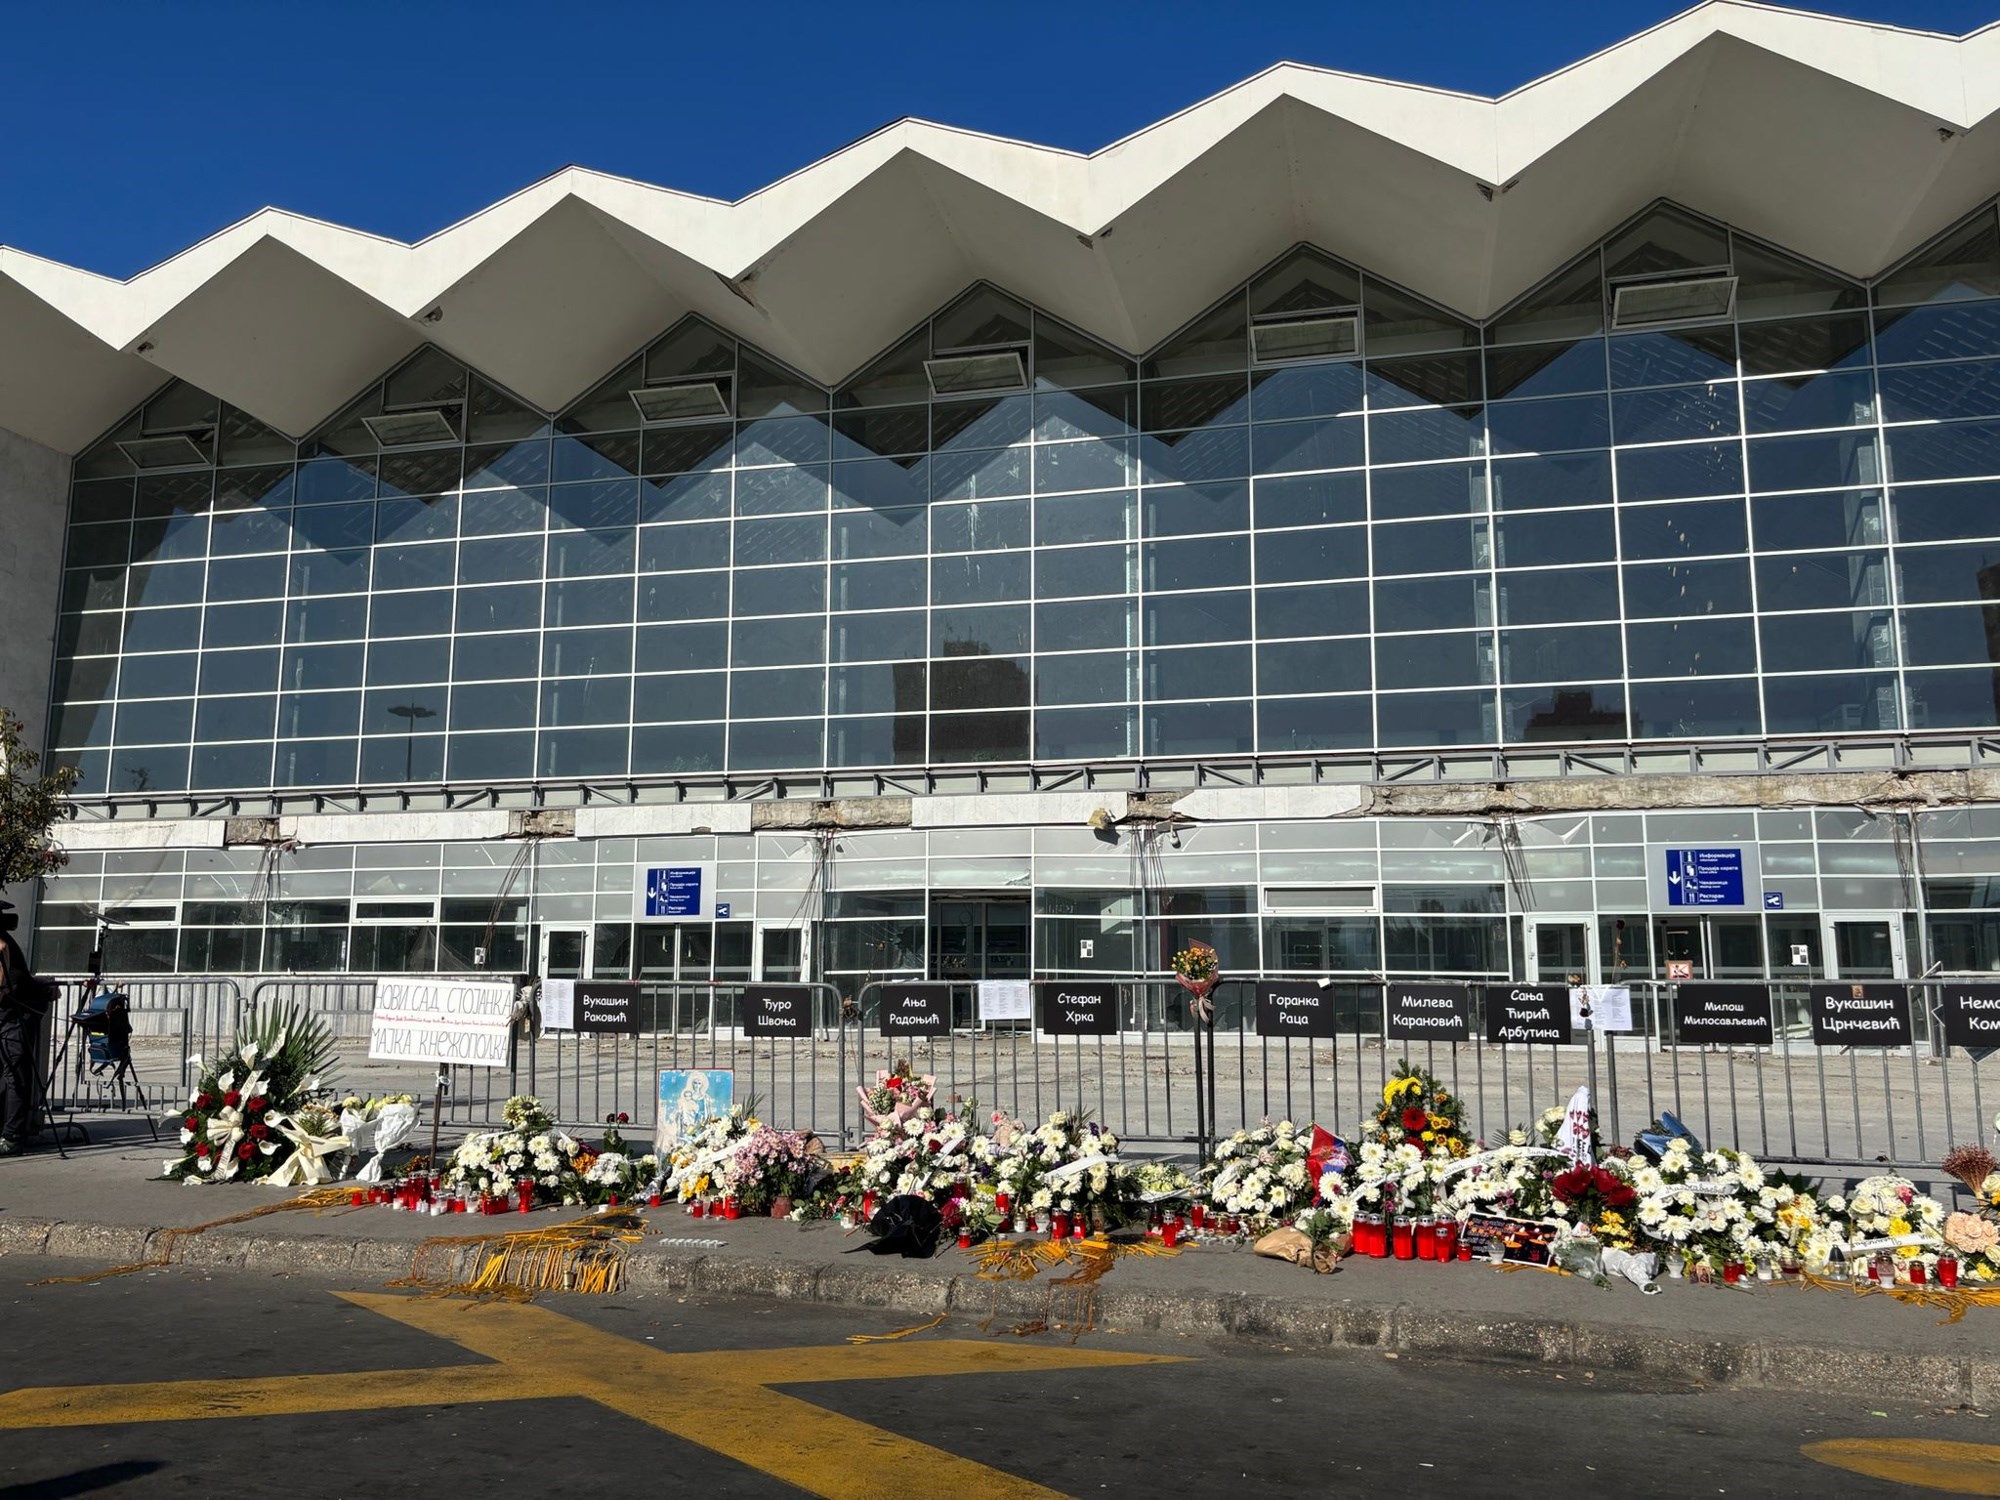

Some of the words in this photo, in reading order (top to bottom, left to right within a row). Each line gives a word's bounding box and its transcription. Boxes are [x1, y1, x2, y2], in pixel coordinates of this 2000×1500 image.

[412, 985, 440, 1012] САД
[583, 995, 628, 1008] Вукашин
[903, 997, 927, 1007] Ања
[1058, 993, 1101, 1007] Стефан
[1269, 994, 1319, 1008] Горанка
[1402, 996, 1453, 1008] Милева
[1510, 990, 1544, 1001] Сања
[762, 999, 791, 1012] Ђуро
[1704, 1002, 1744, 1012] Милош
[1826, 997, 1894, 1013] Вукашин
[584, 1011, 627, 1022] Раковић
[758, 1016, 796, 1026] Швоња
[889, 1013, 939, 1026] Радоњић
[1066, 1011, 1094, 1024] Хрка
[1279, 1012, 1308, 1025] Раца
[1505, 1007, 1550, 1022] Ћирић
[1684, 1016, 1767, 1026] Милосављевић
[1393, 1014, 1463, 1029] Карановић
[1822, 1017, 1900, 1033] Црнчевић
[1498, 1026, 1560, 1040] Арбутина
